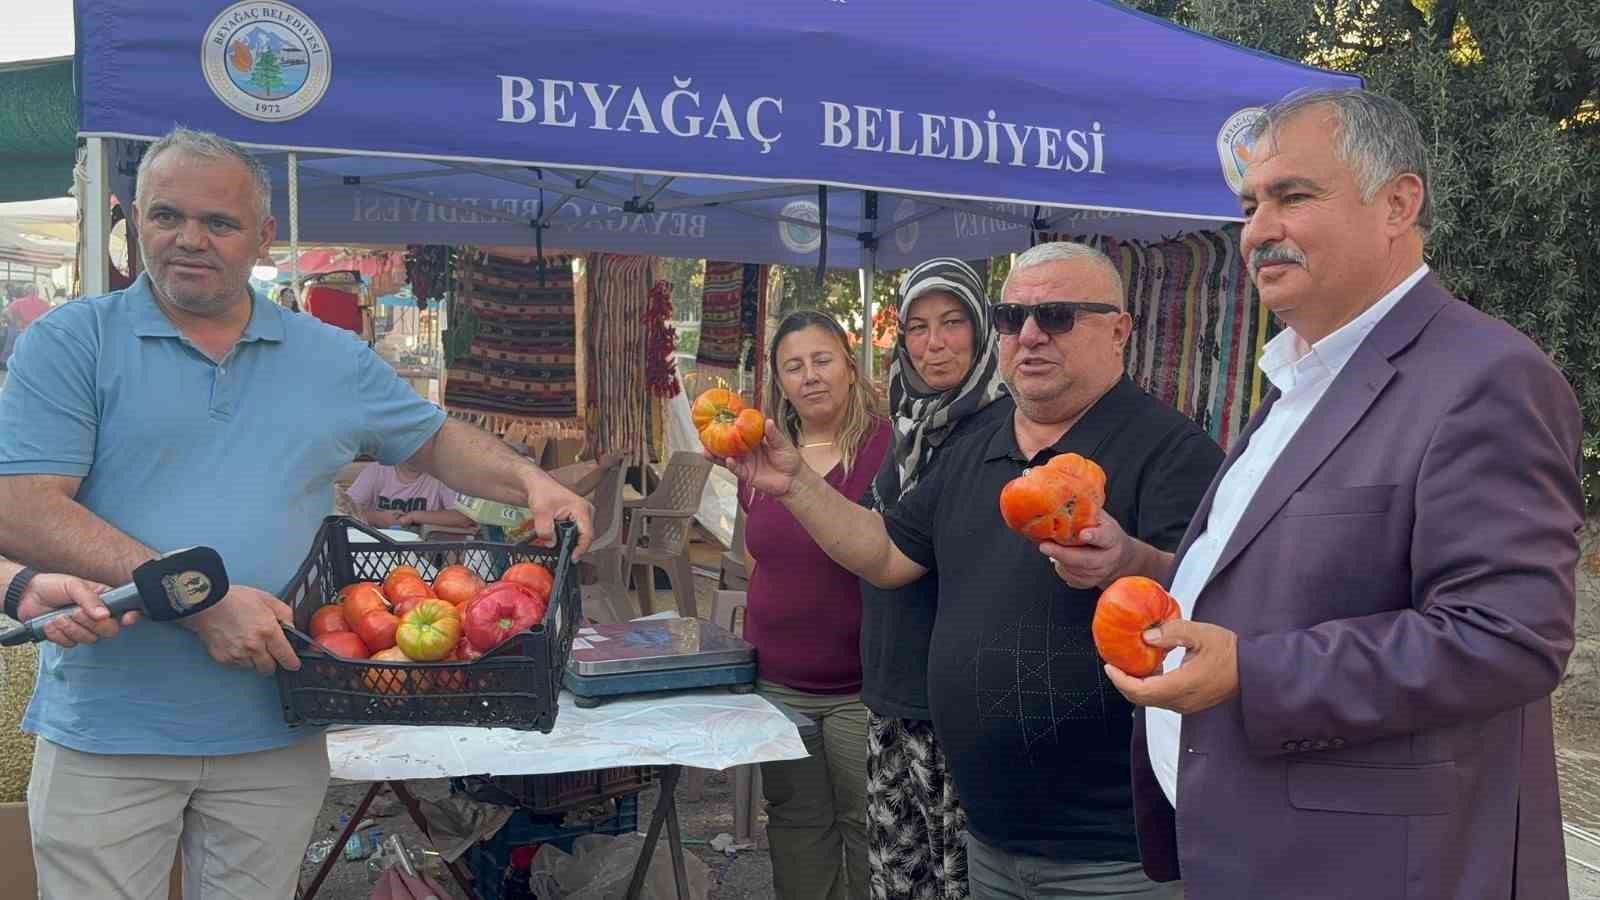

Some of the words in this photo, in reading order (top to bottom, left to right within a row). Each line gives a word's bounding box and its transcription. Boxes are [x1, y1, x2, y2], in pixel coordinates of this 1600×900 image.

[214, 8, 259, 46] BEYAĞAÇ
[255, 103, 281, 113] 1972
[496, 74, 784, 154] BEYAĞAÇ
[820, 101, 1106, 174] BELEDİYESİ
